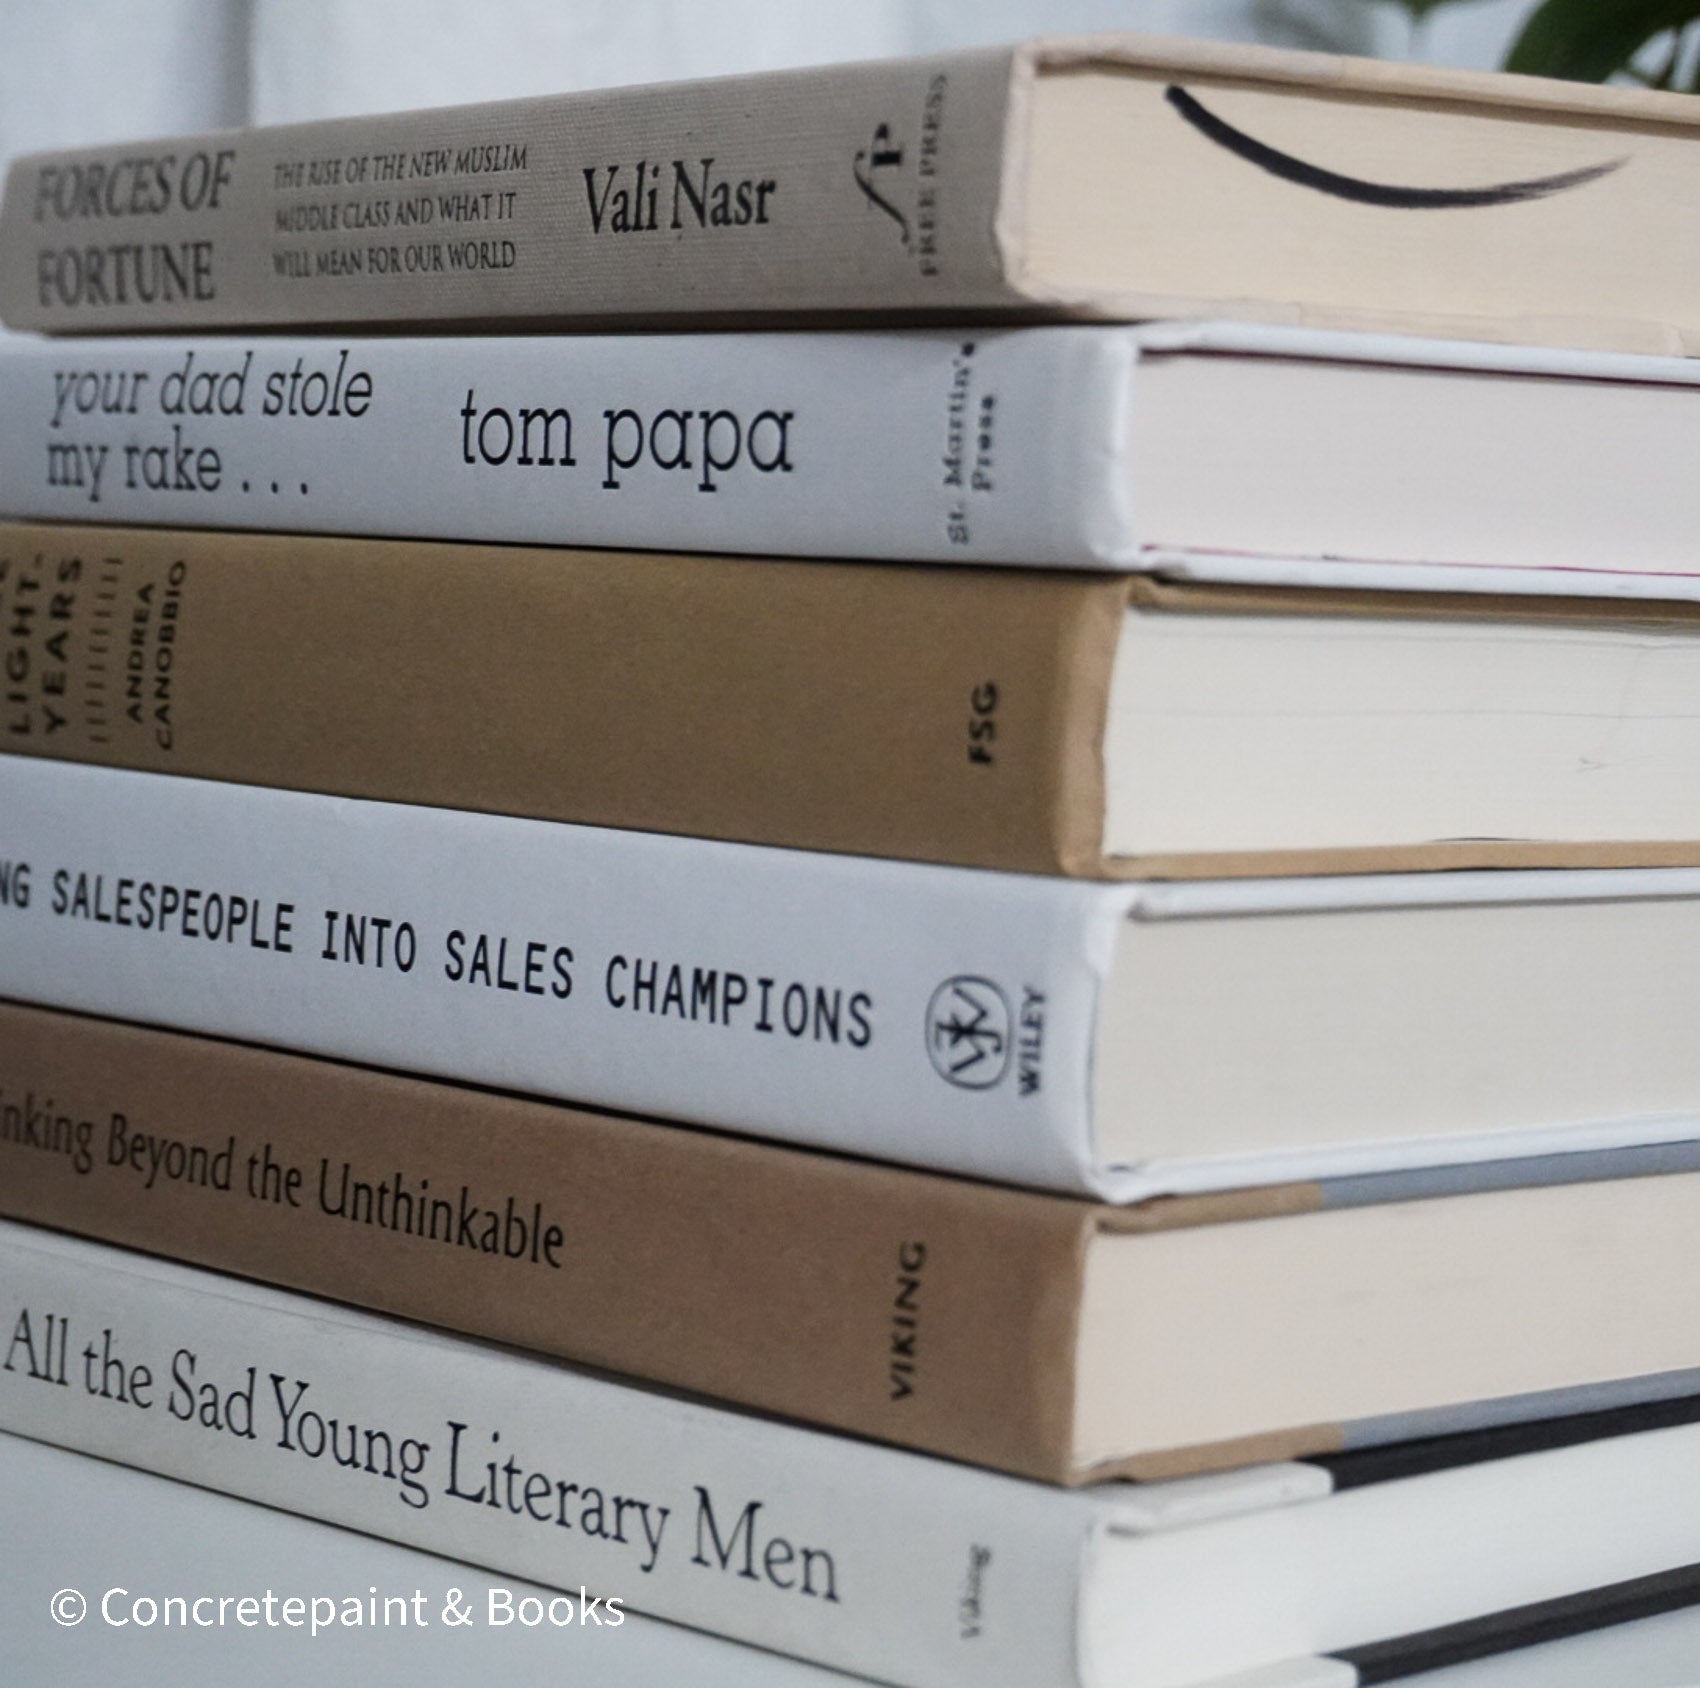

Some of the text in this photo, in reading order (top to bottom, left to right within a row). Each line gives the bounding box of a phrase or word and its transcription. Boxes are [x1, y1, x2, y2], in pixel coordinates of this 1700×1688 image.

[34, 149, 236, 222] FORCES OF
[274, 144, 528, 189] THE RISE OF THE NEW MUSLIM
[275, 192, 517, 232] MIDDLE CLASS AND WHAT IT
[583, 158, 776, 234] Vali Nasr
[37, 241, 216, 307] FORTUNE
[273, 240, 517, 278] WILL MEAN FOR OUR WORLD
[50, 350, 373, 428] your dad stole
[47, 441, 109, 502] my
[125, 424, 222, 492] rake
[461, 388, 794, 492] tom papa
[42, 558, 83, 735] YEARS
[126, 582, 155, 724] ANDREA
[155, 559, 187, 751] CANOBBIO
[968, 681, 998, 767] FSG
[52, 869, 295, 954] SALESPEOPLE
[321, 910, 417, 973] INTO
[444, 929, 574, 999] SALES
[605, 954, 873, 1049] CHAMPIONS
[1018, 984, 1047, 1098] WILEY
[0, 1090, 565, 1269] nking Beyond the Unthinkable
[892, 1240, 928, 1402] VIKING
[3, 1308, 70, 1387] All
[82, 1328, 153, 1409] the
[168, 1348, 257, 1440] Sad
[269, 1372, 431, 1509] Young
[445, 1420, 670, 1573] Literary
[691, 1485, 841, 1604] Men
